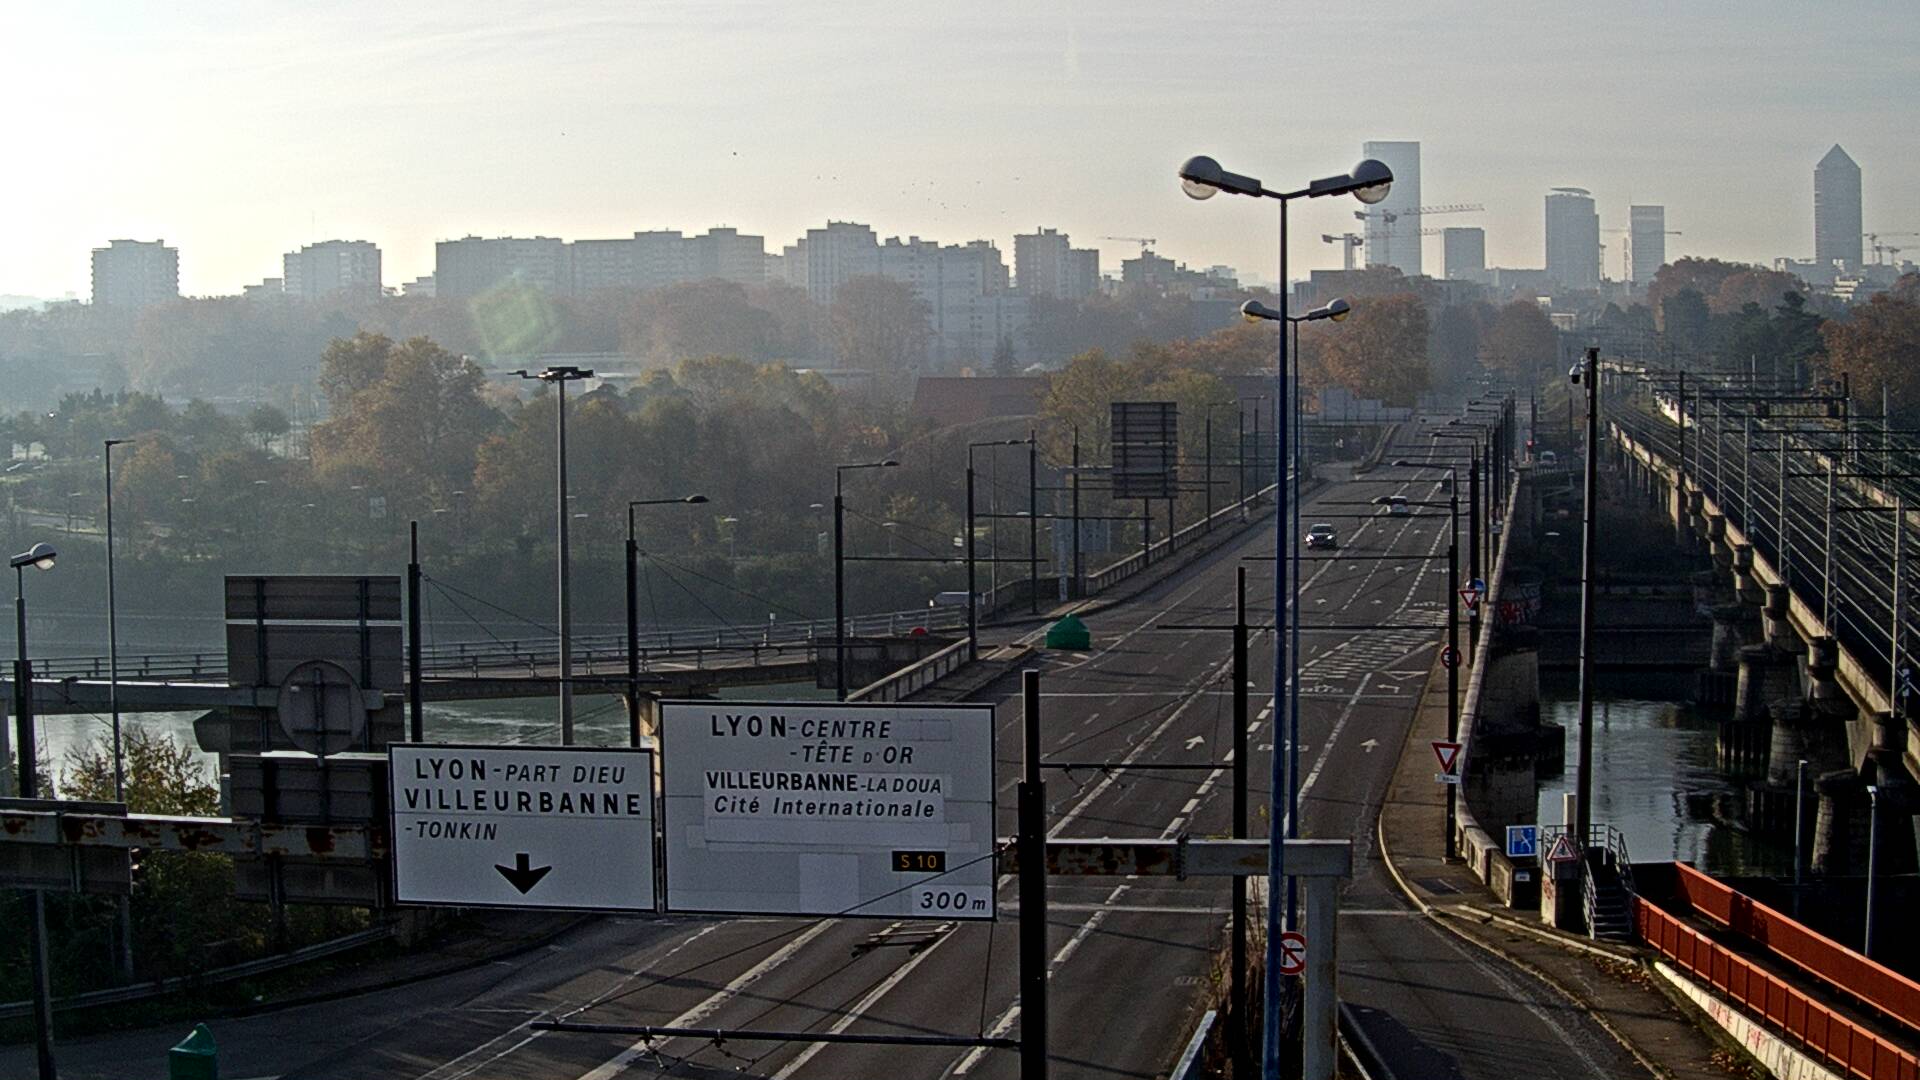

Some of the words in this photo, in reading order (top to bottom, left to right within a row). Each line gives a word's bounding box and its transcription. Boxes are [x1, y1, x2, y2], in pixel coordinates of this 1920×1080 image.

[572, 765, 626, 784] DIEU
[892, 778, 942, 793] DOUA
[404, 788, 641, 815] VILLEURBANNE
[714, 796, 760, 814] Cité
[773, 797, 935, 818] Internationale
